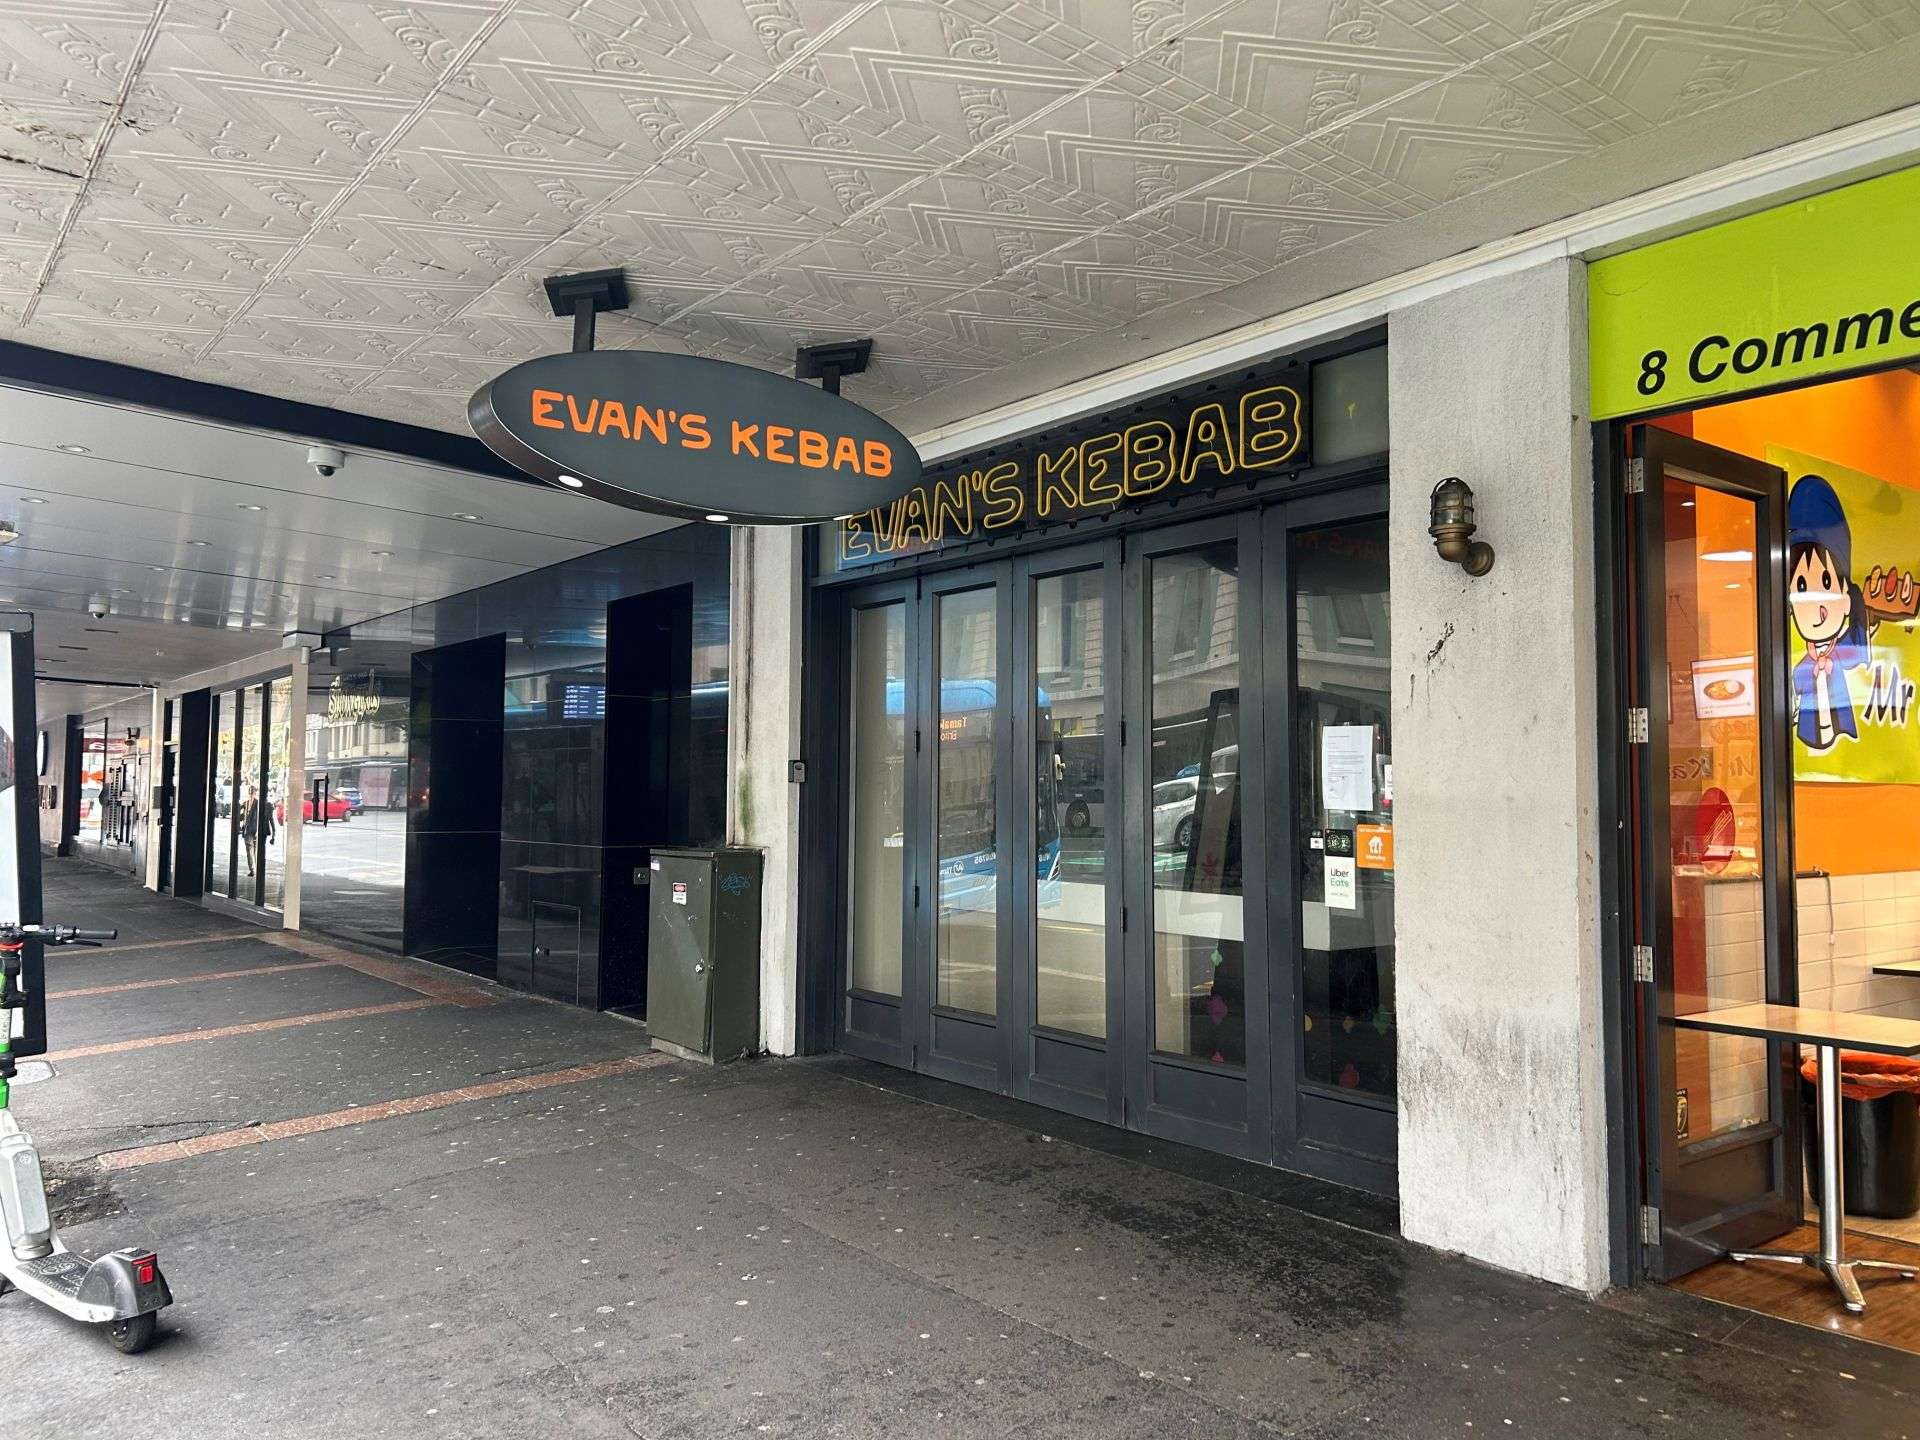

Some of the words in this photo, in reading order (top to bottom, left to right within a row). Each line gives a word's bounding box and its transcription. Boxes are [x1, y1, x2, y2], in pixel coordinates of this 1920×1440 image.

[1637, 350, 1668, 395] 8
[531, 389, 711, 449] EVAN'S
[731, 420, 893, 478] KEBAB
[840, 461, 1025, 561] EVAN'S
[1036, 385, 1302, 517] KEBAB
[1863, 664, 1914, 724] Mr
[1330, 867, 1350, 877] Uber
[1330, 878, 1350, 888] Eats
